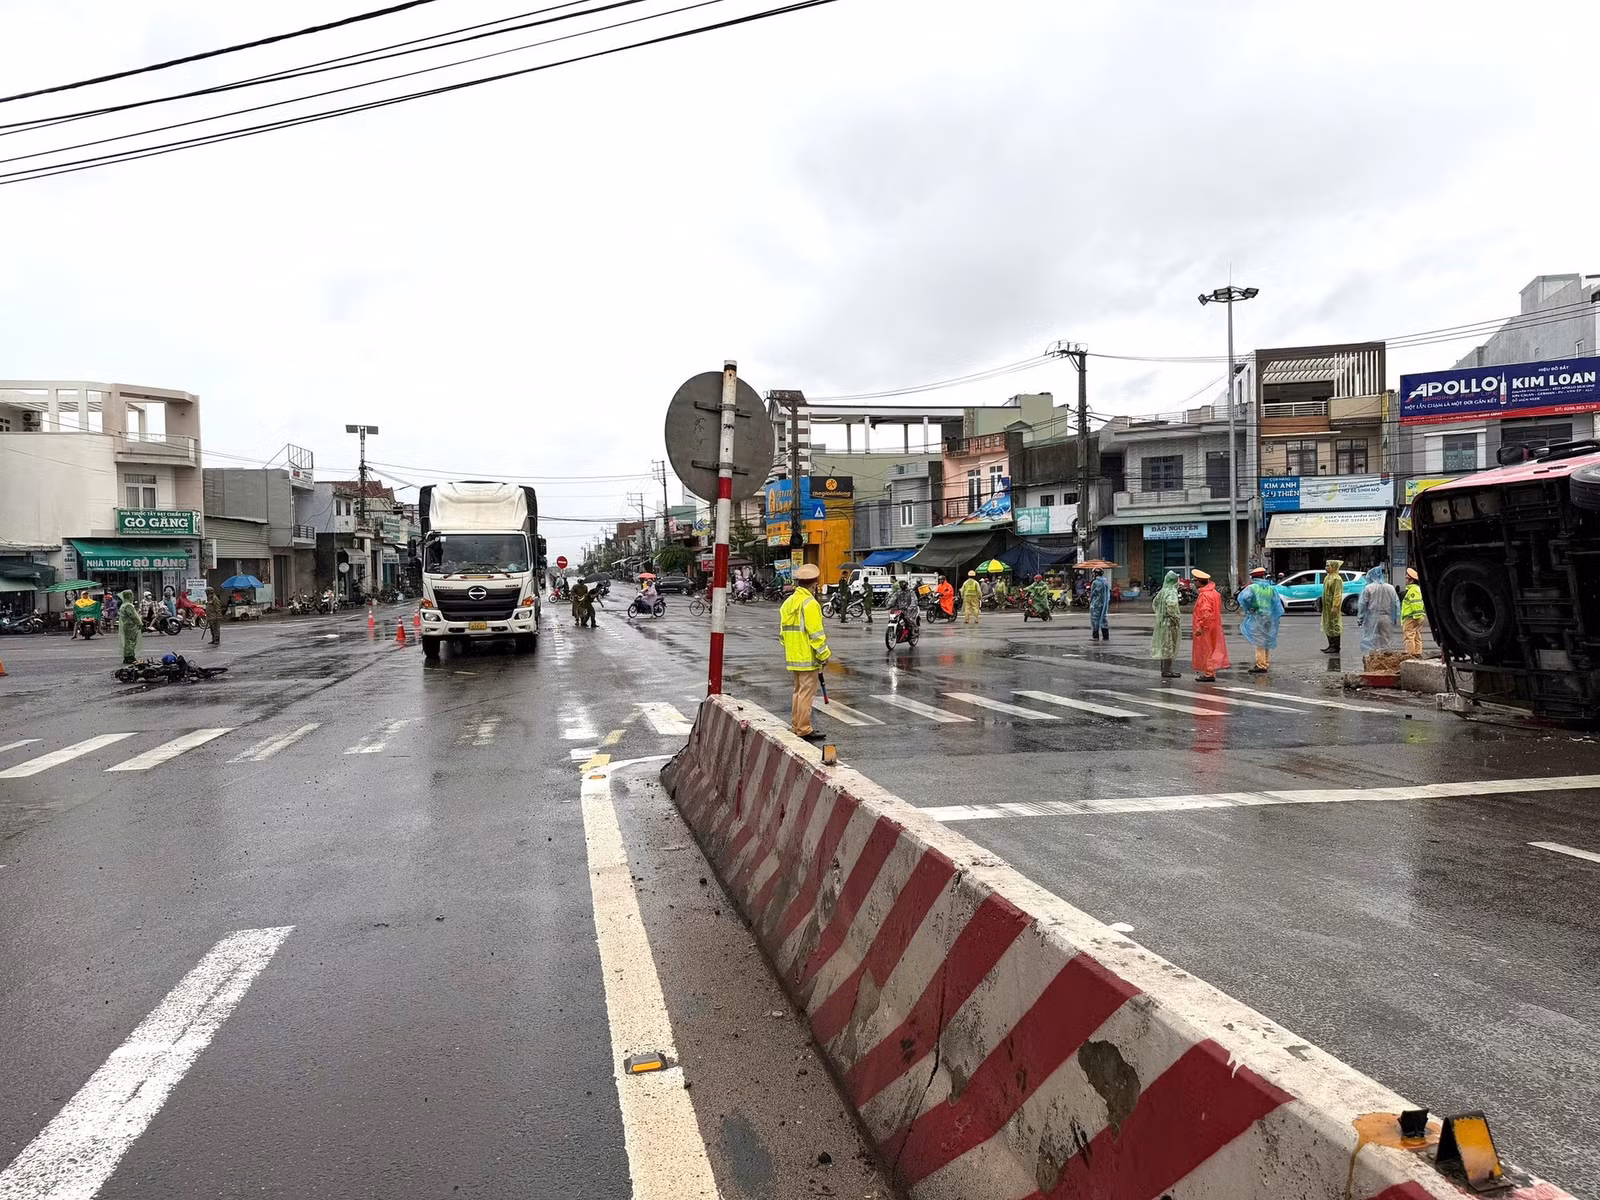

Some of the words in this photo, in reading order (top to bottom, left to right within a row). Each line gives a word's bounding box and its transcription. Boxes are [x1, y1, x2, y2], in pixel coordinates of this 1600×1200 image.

[1512, 376, 1544, 389] KIM
[1549, 371, 1596, 386] LOAN
[1406, 376, 1498, 401] APOLLO
[124, 515, 146, 528] GÒ
[86, 558, 104, 567] NHÀ
[106, 556, 132, 567] THUỐC
[132, 556, 150, 568] GÒ
[153, 557, 187, 568] GĂNG
